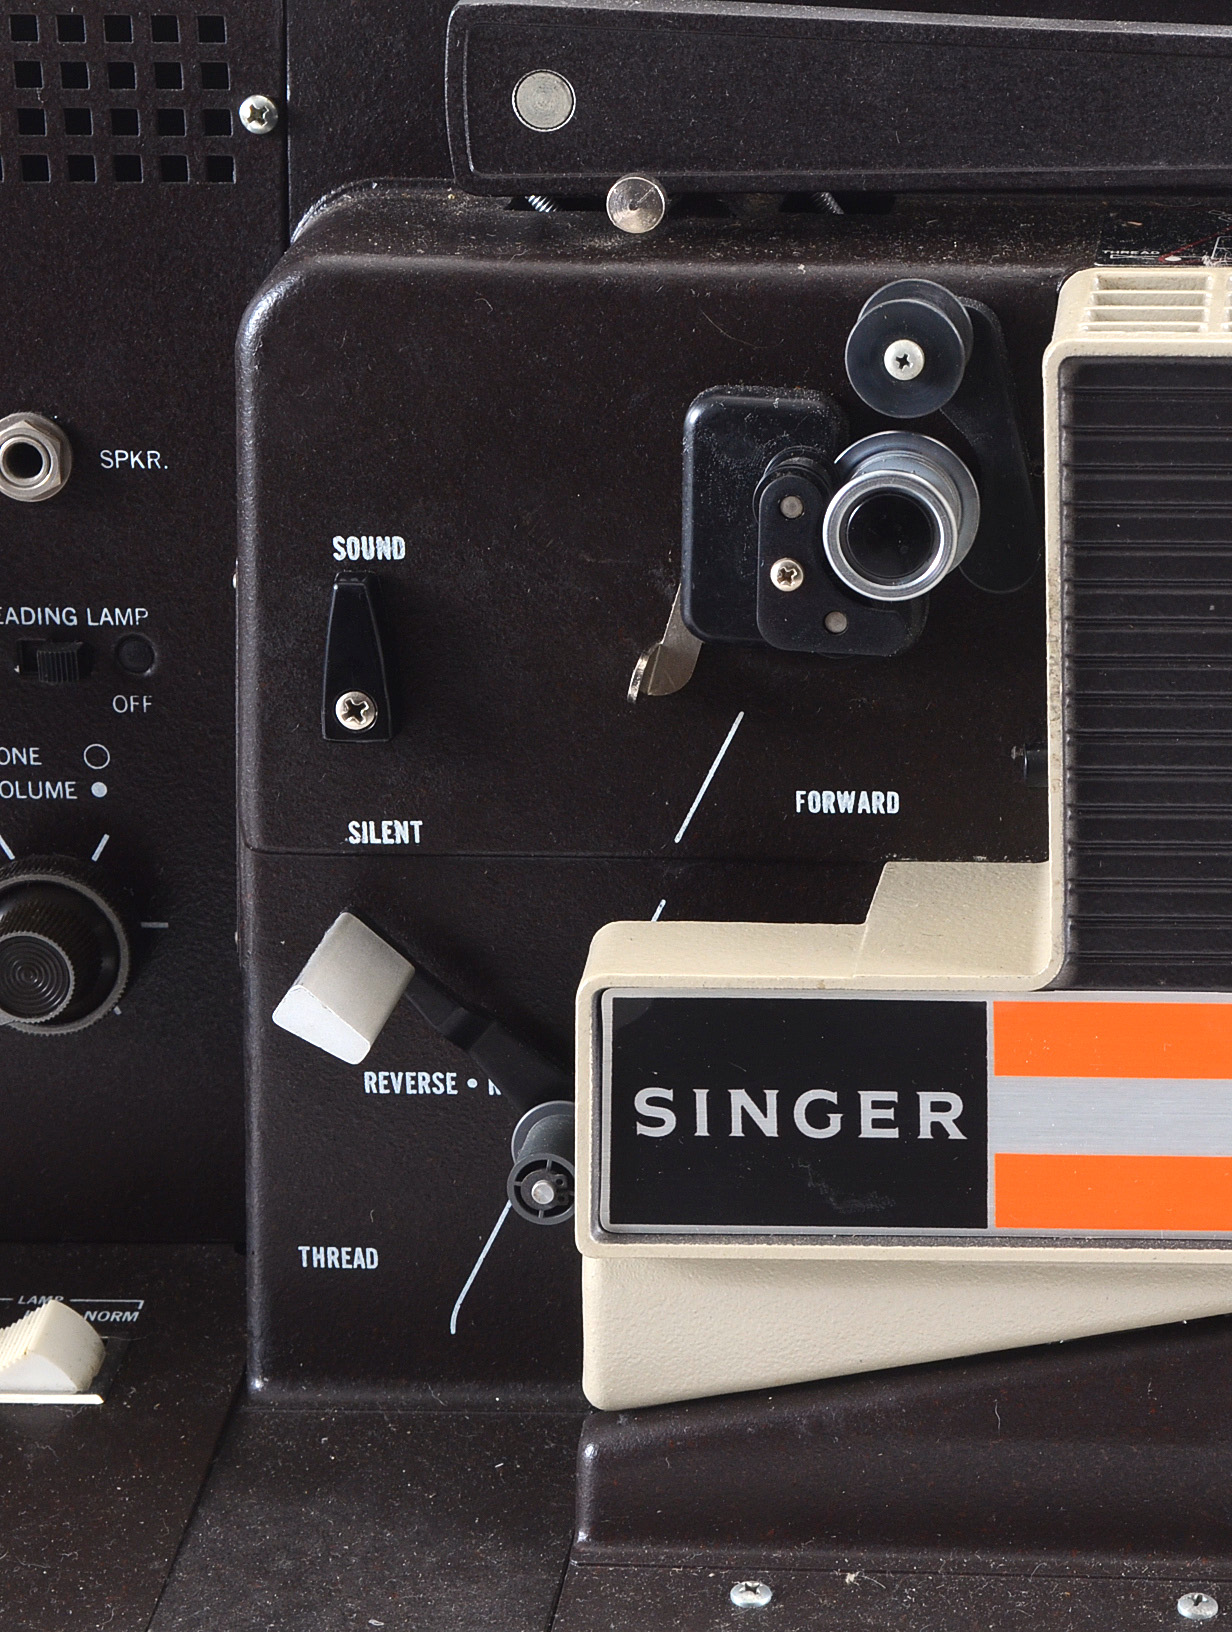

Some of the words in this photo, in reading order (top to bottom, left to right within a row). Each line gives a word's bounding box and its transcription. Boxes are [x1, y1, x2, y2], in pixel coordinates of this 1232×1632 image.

[100, 449, 169, 470] SPKR.
[332, 535, 406, 561] SOUND
[86, 607, 149, 626] LAMP
[112, 694, 153, 714] OFF
[795, 790, 900, 814] FORWARD
[347, 820, 424, 845] SILENT
[363, 1071, 459, 1096] REVERSE
[633, 1086, 968, 1141] SINGER
[297, 1245, 379, 1270] THREAD
[83, 1310, 140, 1323] NORM
